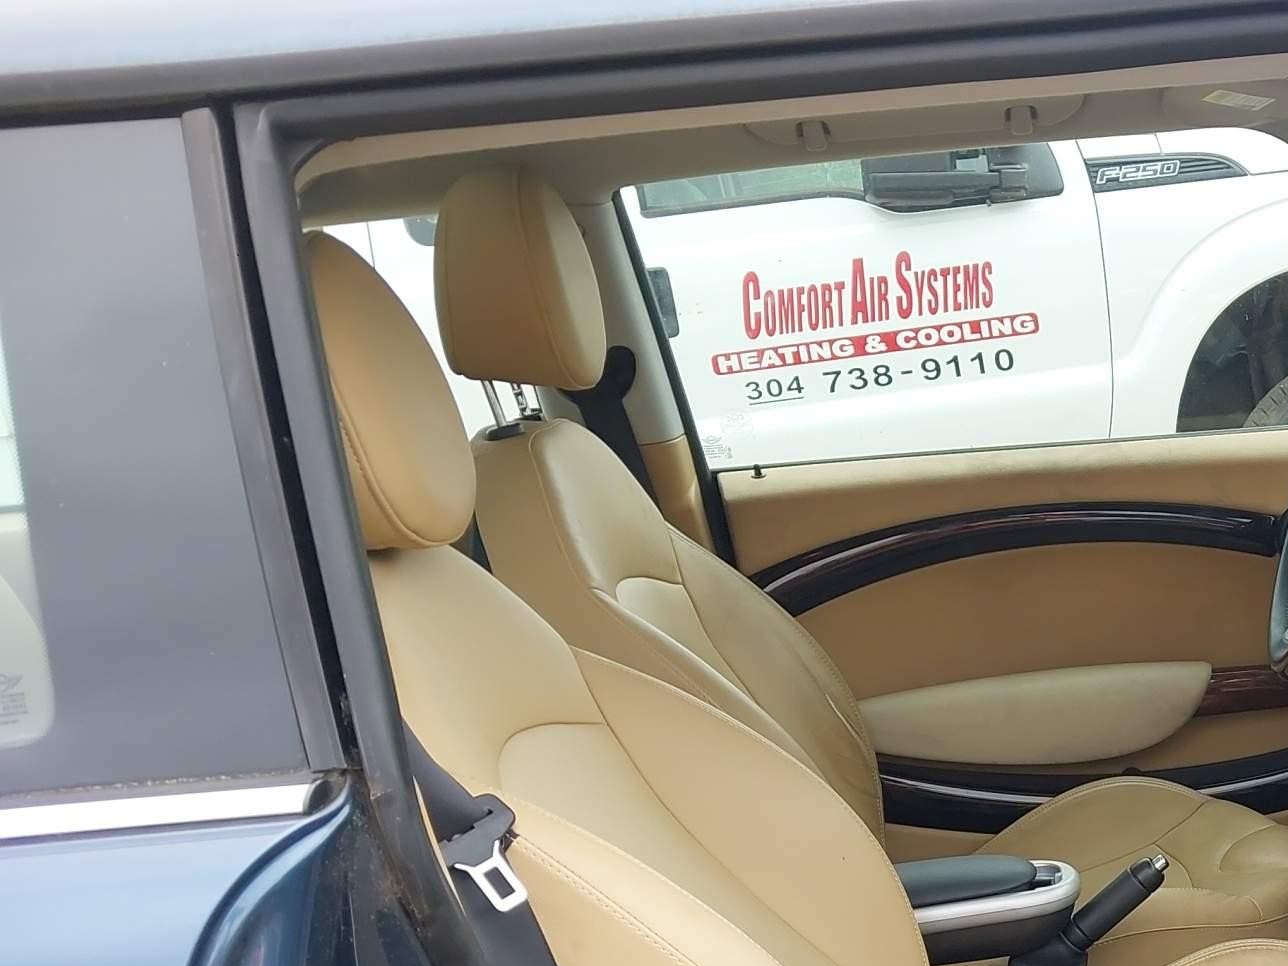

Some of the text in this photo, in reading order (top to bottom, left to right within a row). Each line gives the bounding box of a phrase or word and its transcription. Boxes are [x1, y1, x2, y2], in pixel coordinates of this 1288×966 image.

[1096, 160, 1180, 185] F-250
[742, 250, 993, 340] COMFORT AIR SYSTEMS
[716, 314, 1037, 373] HEATING & COOLING
[744, 348, 1014, 401] 304 738-9110
